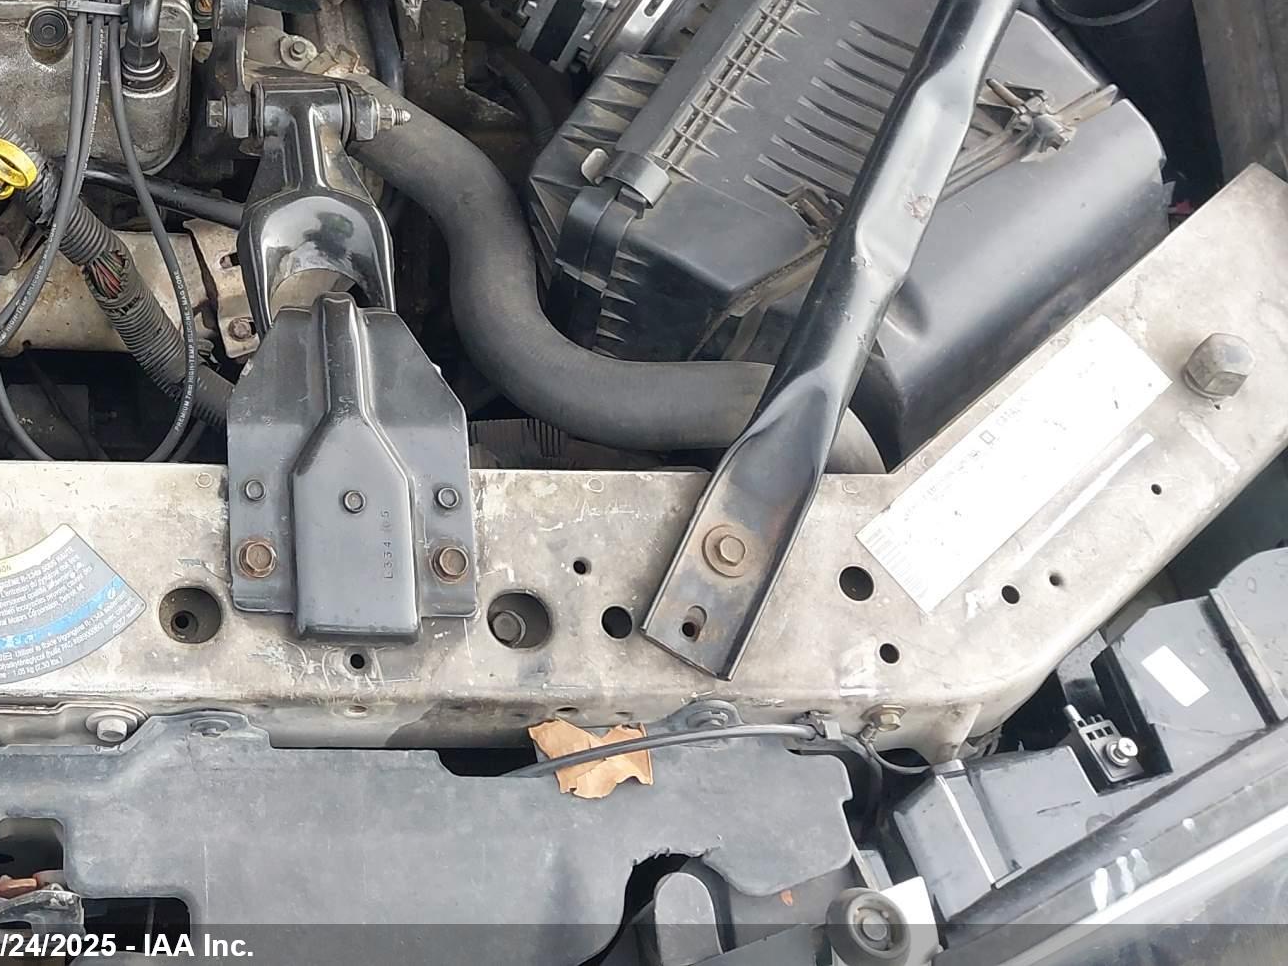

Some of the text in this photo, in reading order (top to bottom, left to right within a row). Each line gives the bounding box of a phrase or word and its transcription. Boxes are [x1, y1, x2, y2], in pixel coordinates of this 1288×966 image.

[26, 265, 45, 297] SILICONE
[173, 271, 184, 290] CORE
[185, 312, 194, 343] SILICONE
[174, 400, 190, 432] PREMIUM
[7, 612, 27, 623] Motors
